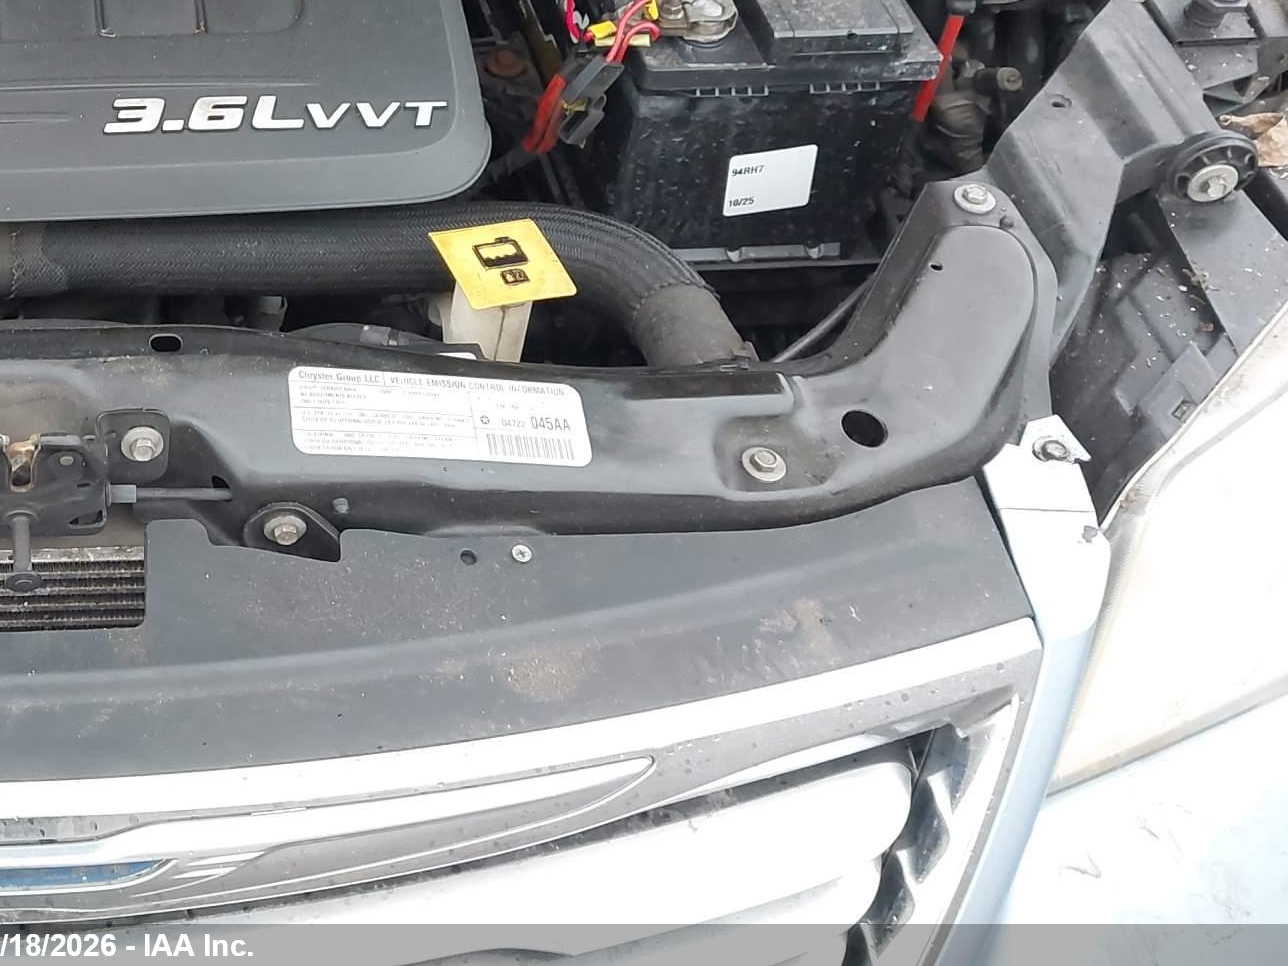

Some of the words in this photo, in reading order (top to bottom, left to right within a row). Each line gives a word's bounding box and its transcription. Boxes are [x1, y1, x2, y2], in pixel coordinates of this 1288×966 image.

[731, 165, 764, 176] 94RH7
[728, 196, 754, 207] 10/25
[298, 370, 333, 381] Chrysler
[335, 372, 361, 384] Group
[364, 374, 380, 383] LLC
[426, 378, 466, 389] EMISSION
[469, 381, 505, 392] CONTROL
[509, 385, 565, 395] INFORMATION
[530, 416, 571, 433] 045AA
